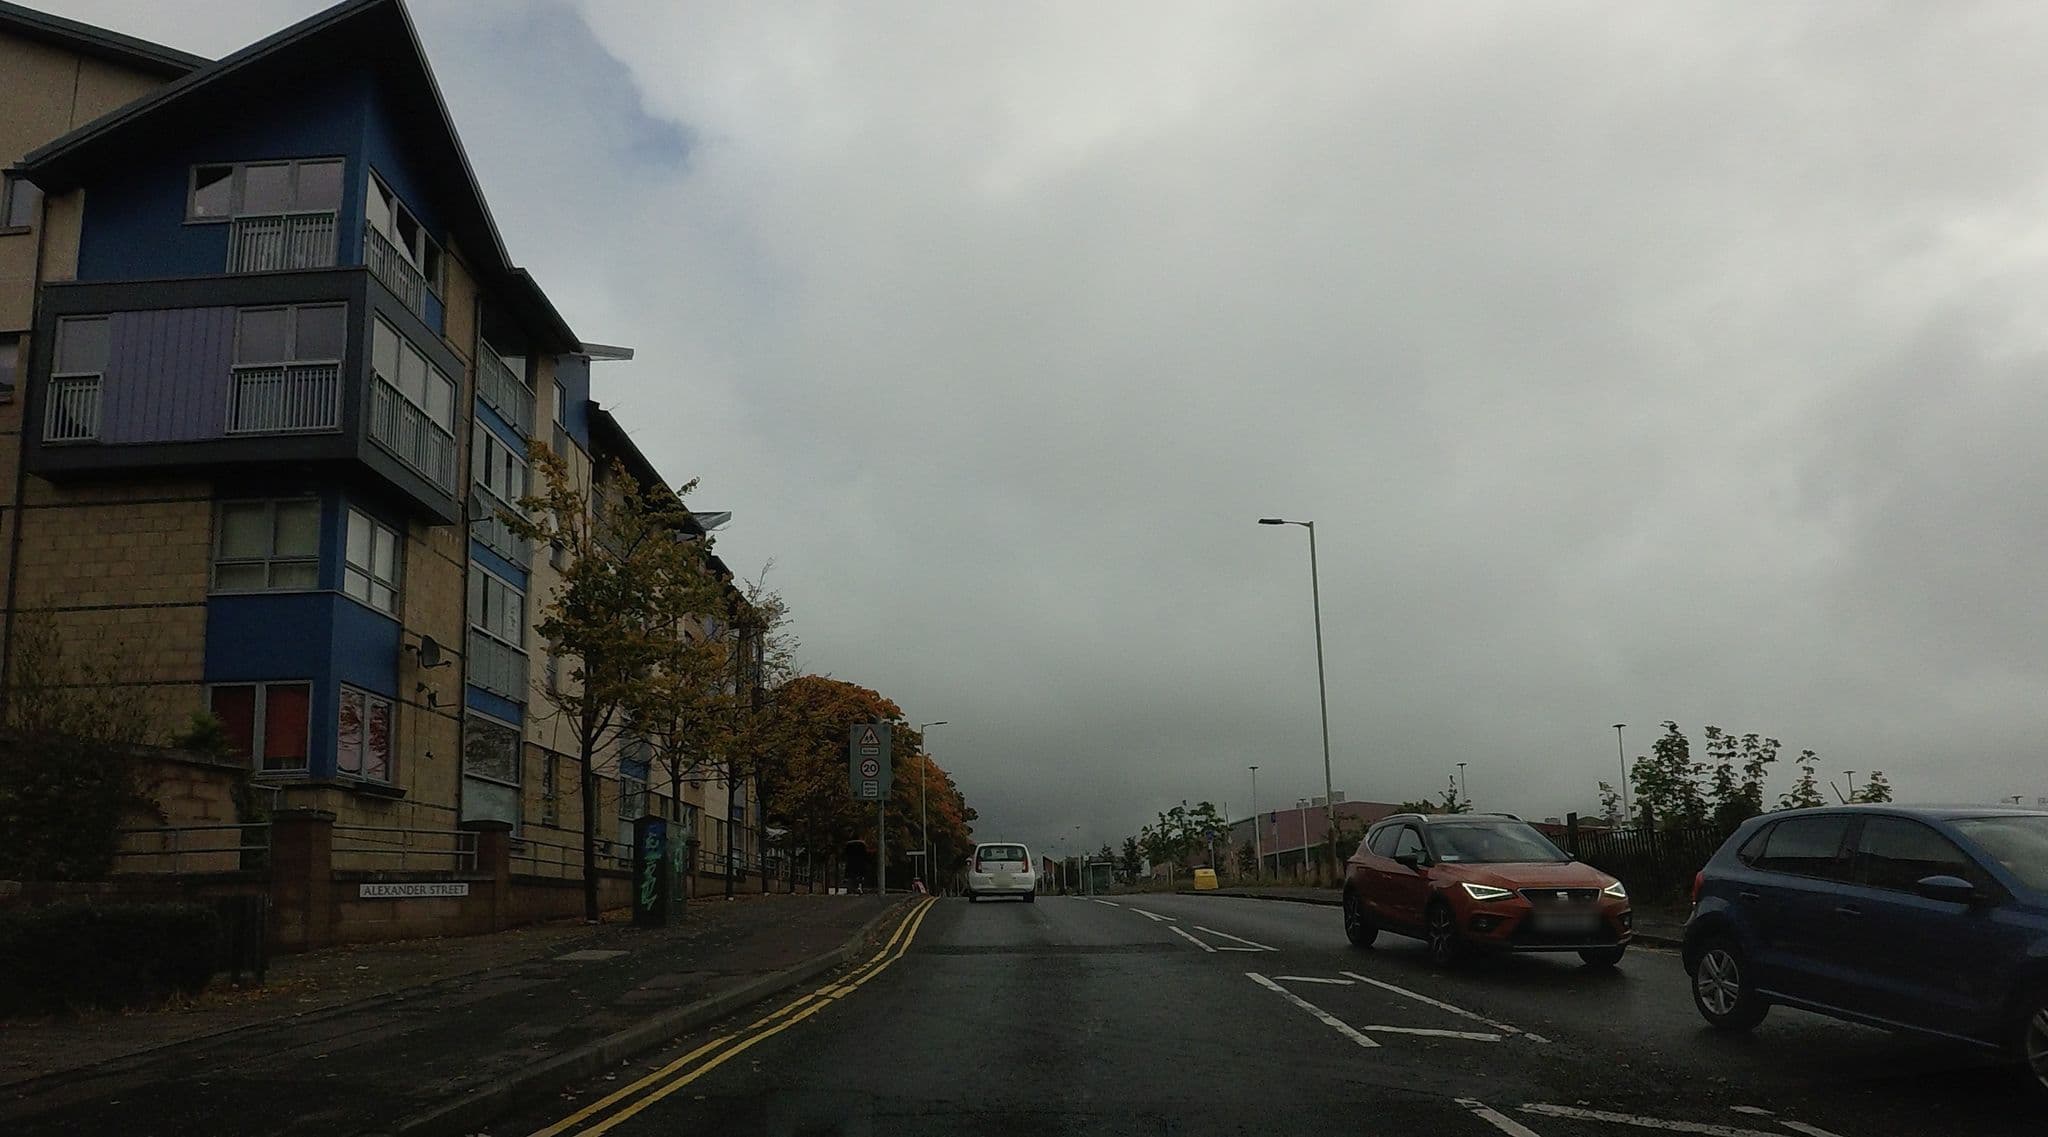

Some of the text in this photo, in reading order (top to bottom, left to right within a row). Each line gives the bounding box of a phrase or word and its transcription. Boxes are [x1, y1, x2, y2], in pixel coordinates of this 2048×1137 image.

[863, 764, 877, 773] 20
[363, 884, 465, 896] ALEXANDER STREET
